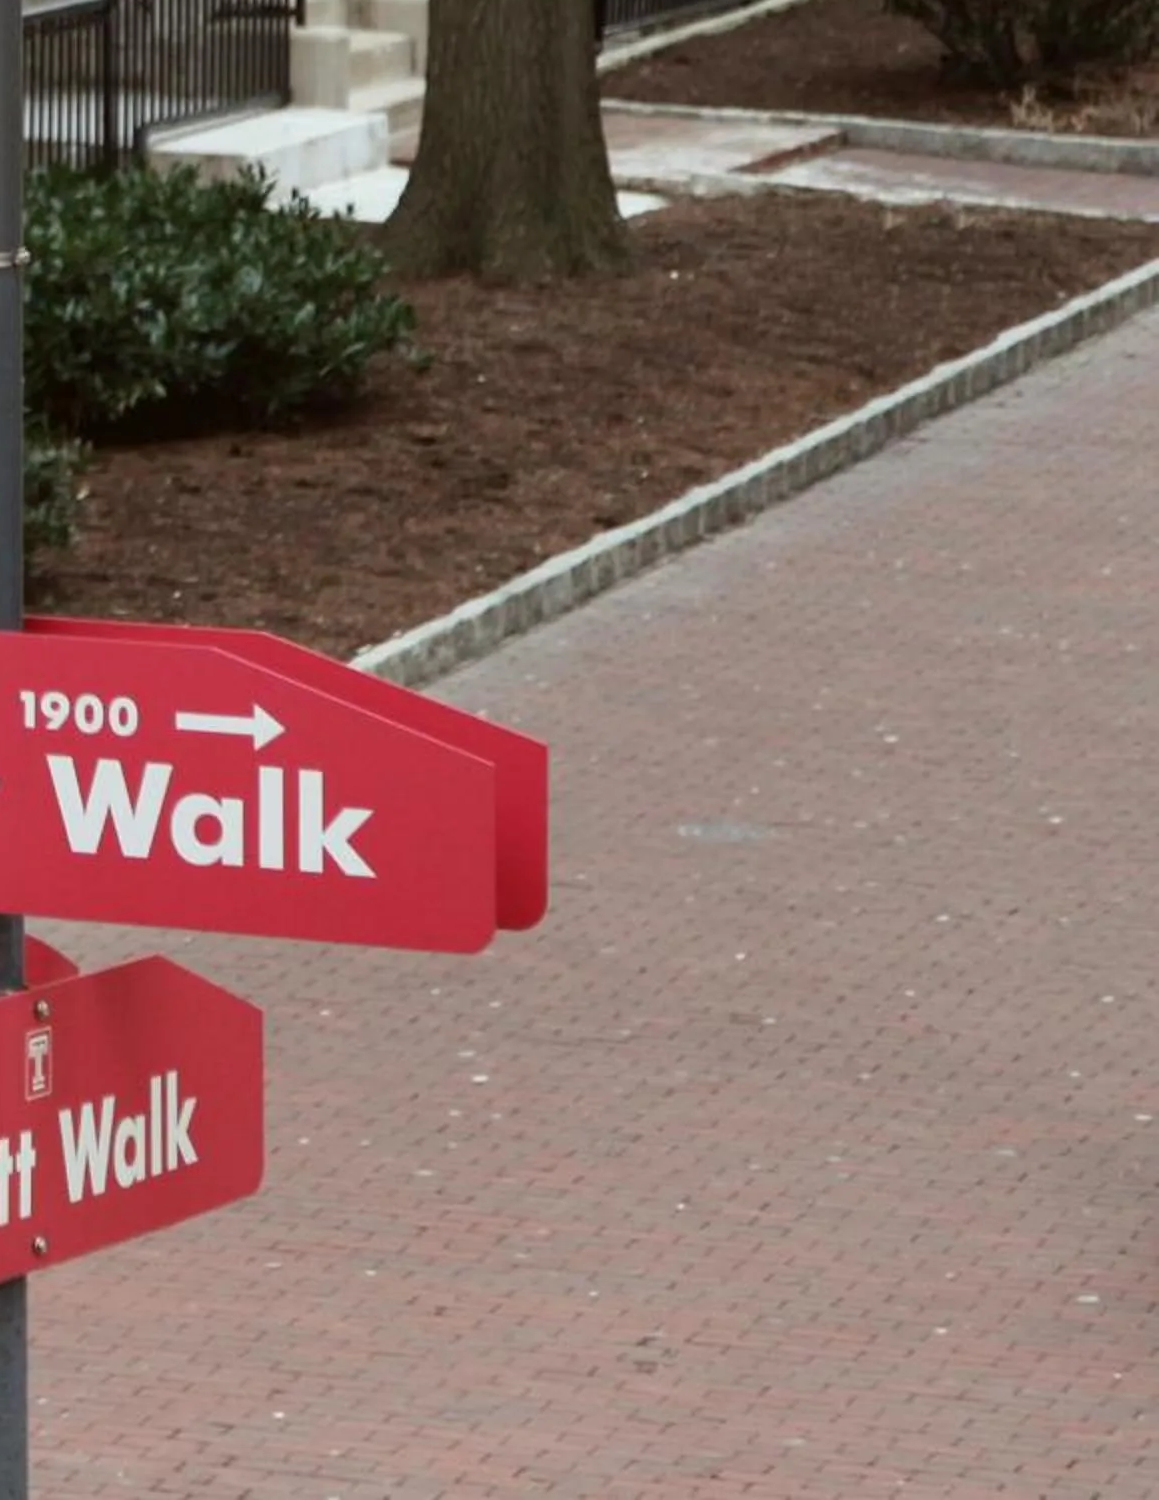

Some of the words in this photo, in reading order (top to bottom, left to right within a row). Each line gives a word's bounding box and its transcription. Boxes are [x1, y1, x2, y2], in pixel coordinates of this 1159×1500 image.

[19, 690, 139, 738] 1900
[45, 753, 377, 879] Walk
[58, 1070, 199, 1204] Walk
